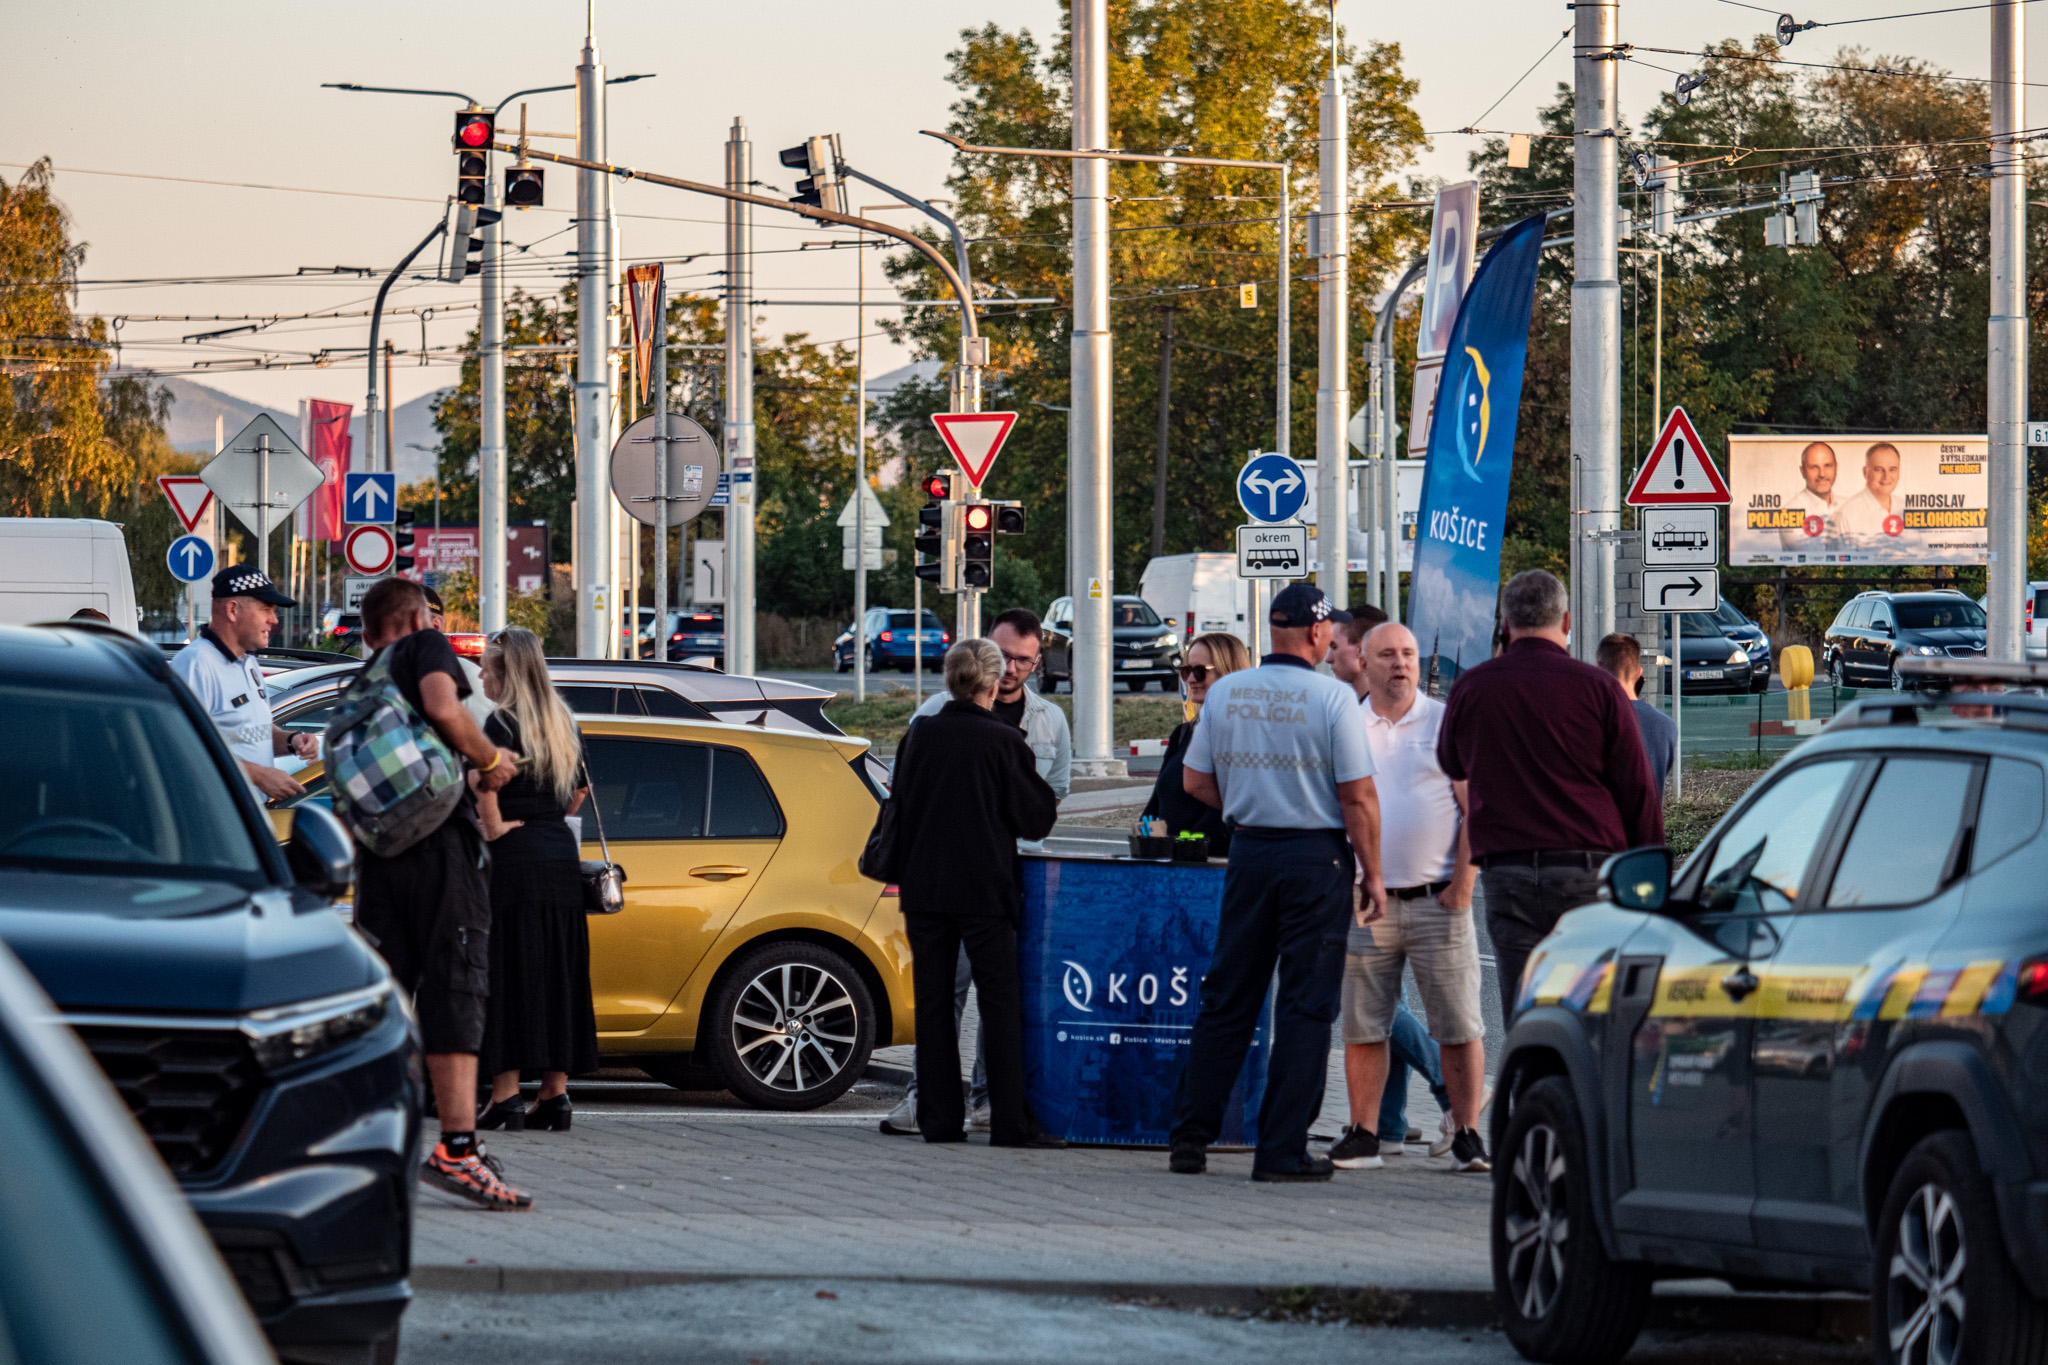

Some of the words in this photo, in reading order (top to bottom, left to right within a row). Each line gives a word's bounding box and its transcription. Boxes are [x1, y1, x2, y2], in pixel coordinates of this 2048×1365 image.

[1940, 444, 1965, 453] ČESTNE
[1946, 453, 1987, 462] VÝSLEDKAMI
[1940, 464, 1955, 474] PRE
[1955, 463, 1980, 474] KOŠICE
[1749, 494, 1781, 508] JARO
[1905, 494, 1965, 508] MIROSLAV
[1748, 509, 1804, 528] POLAČEK
[1905, 508, 1986, 527] BELOHORSKÝ
[1430, 506, 1488, 551] KOŠICE
[1889, 519, 1898, 533] 2
[1255, 533, 1290, 543] okrem
[1230, 687, 1307, 705] MESTSKÁ
[1226, 703, 1306, 725] POLÍCIA
[1108, 966, 1188, 1006] KOŠ
